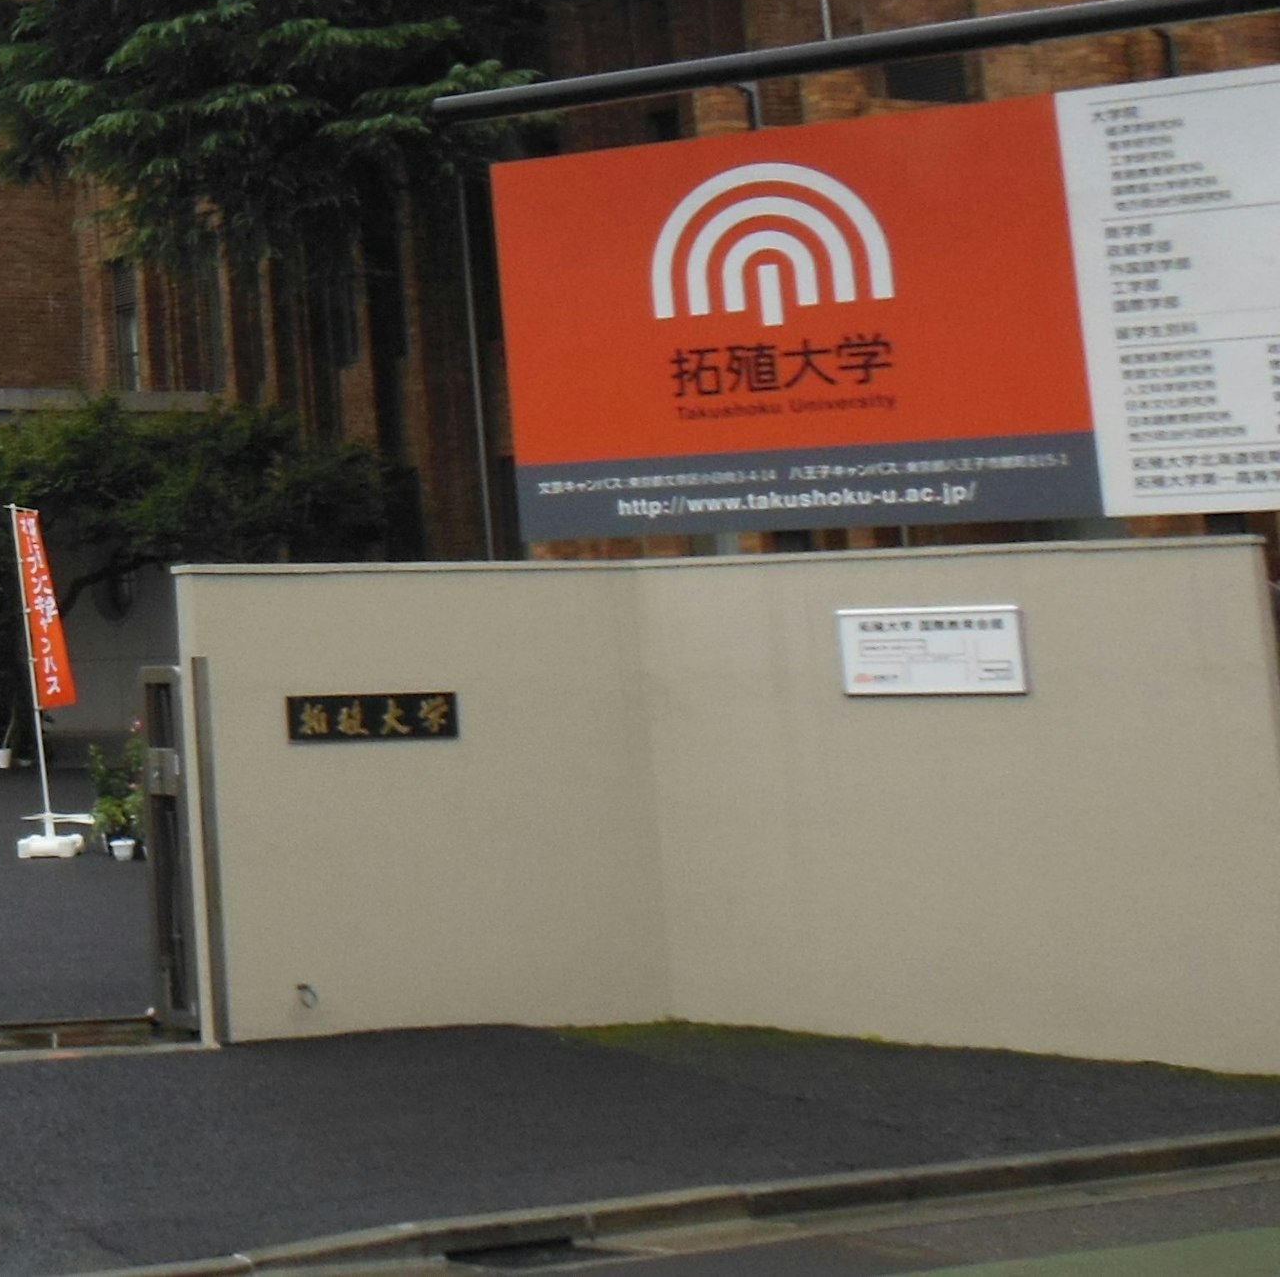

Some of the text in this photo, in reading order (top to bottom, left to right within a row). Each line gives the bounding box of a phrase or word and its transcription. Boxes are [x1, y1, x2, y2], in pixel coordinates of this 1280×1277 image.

[1092, 106, 1138, 122] 大学院
[671, 333, 893, 398] 拓殖大学
[677, 396, 896, 420] Takushoku University
[617, 481, 979, 518] http://www.takushoku-u.ac.jp/
